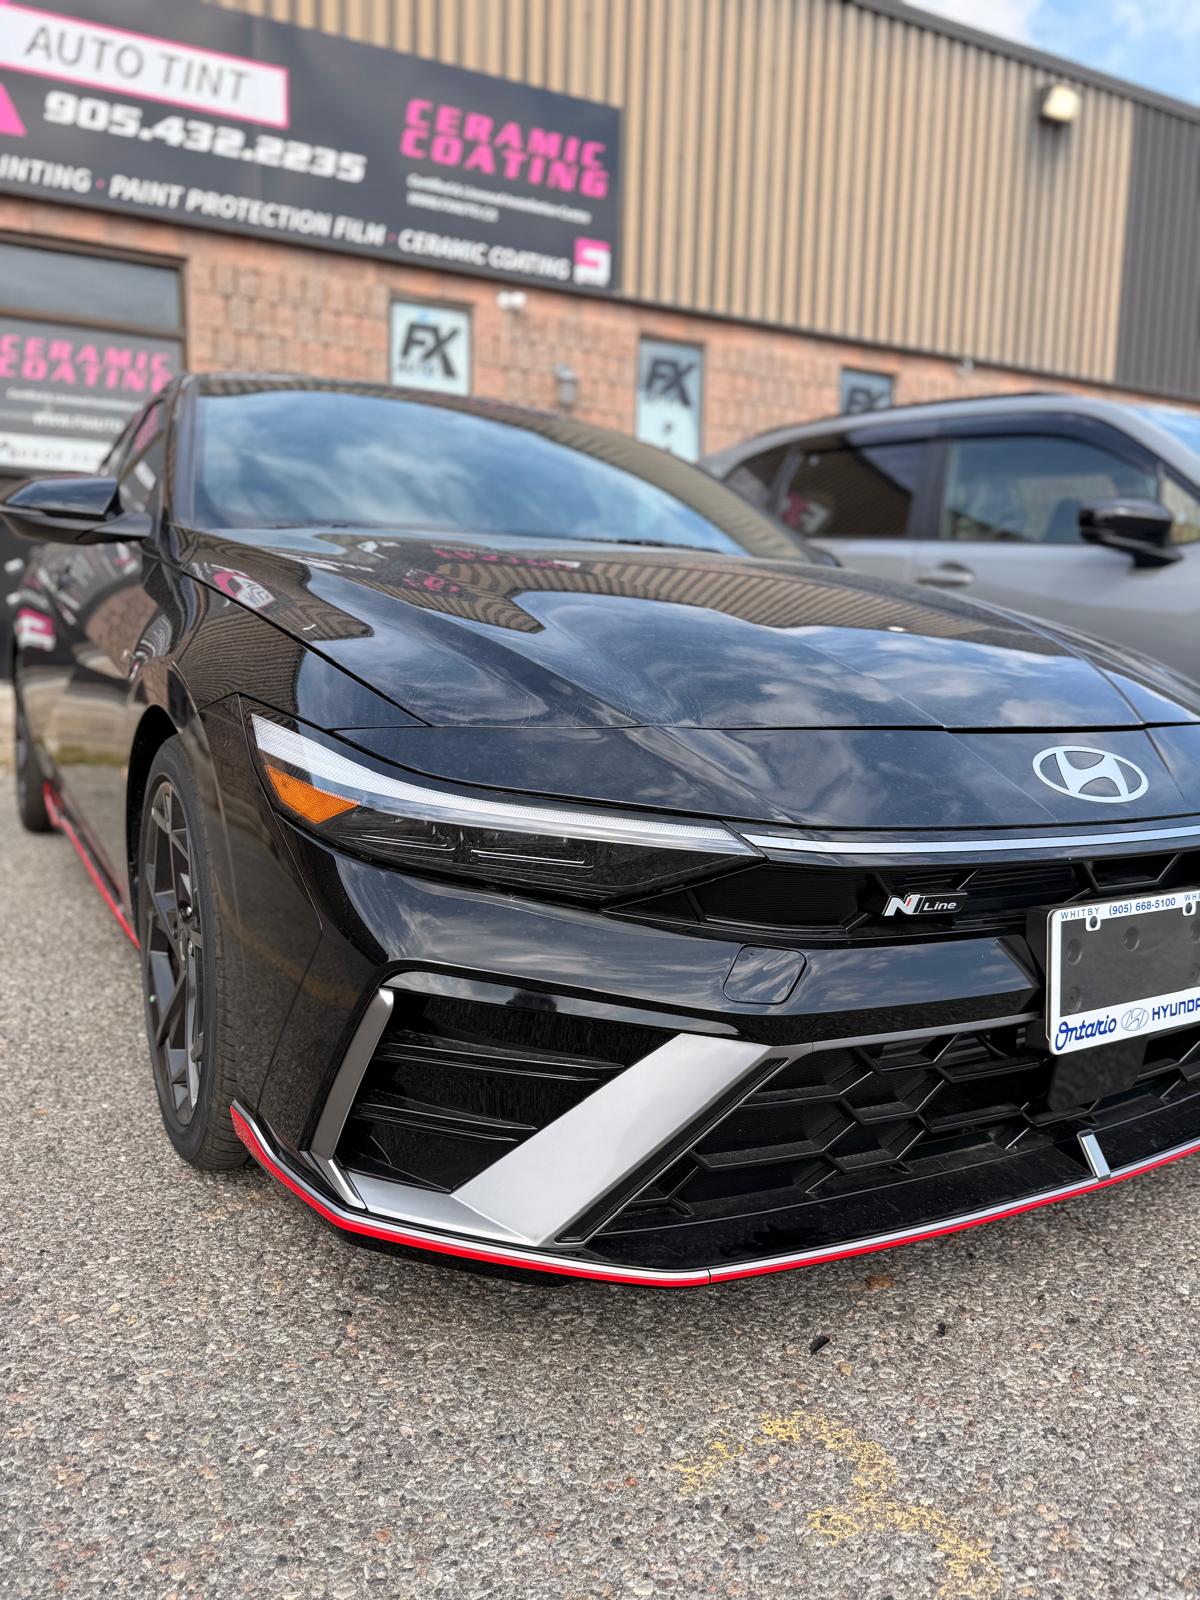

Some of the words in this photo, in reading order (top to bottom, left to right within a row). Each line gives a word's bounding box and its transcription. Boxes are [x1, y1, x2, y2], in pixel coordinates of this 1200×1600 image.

[26, 24, 145, 80] AUTO
[157, 52, 251, 102] TINT
[43, 90, 367, 184] 905.432.2235
[400, 128, 609, 199] COATING
[404, 98, 606, 169] CERAMIC
[108, 174, 185, 209] PAINT
[185, 188, 333, 237] PROTECTION
[332, 215, 387, 247] FILM
[398, 228, 489, 267] CERAMIC
[487, 245, 571, 281] COATING
[402, 322, 459, 379] FX
[645, 359, 696, 408] FX
[923, 902, 957, 911] Line
[1060, 906, 1100, 920] WHITBY
[1109, 904, 1133, 917] (905)
[1135, 897, 1176, 911] 668-5100
[1055, 1015, 1117, 1051] Ontario
